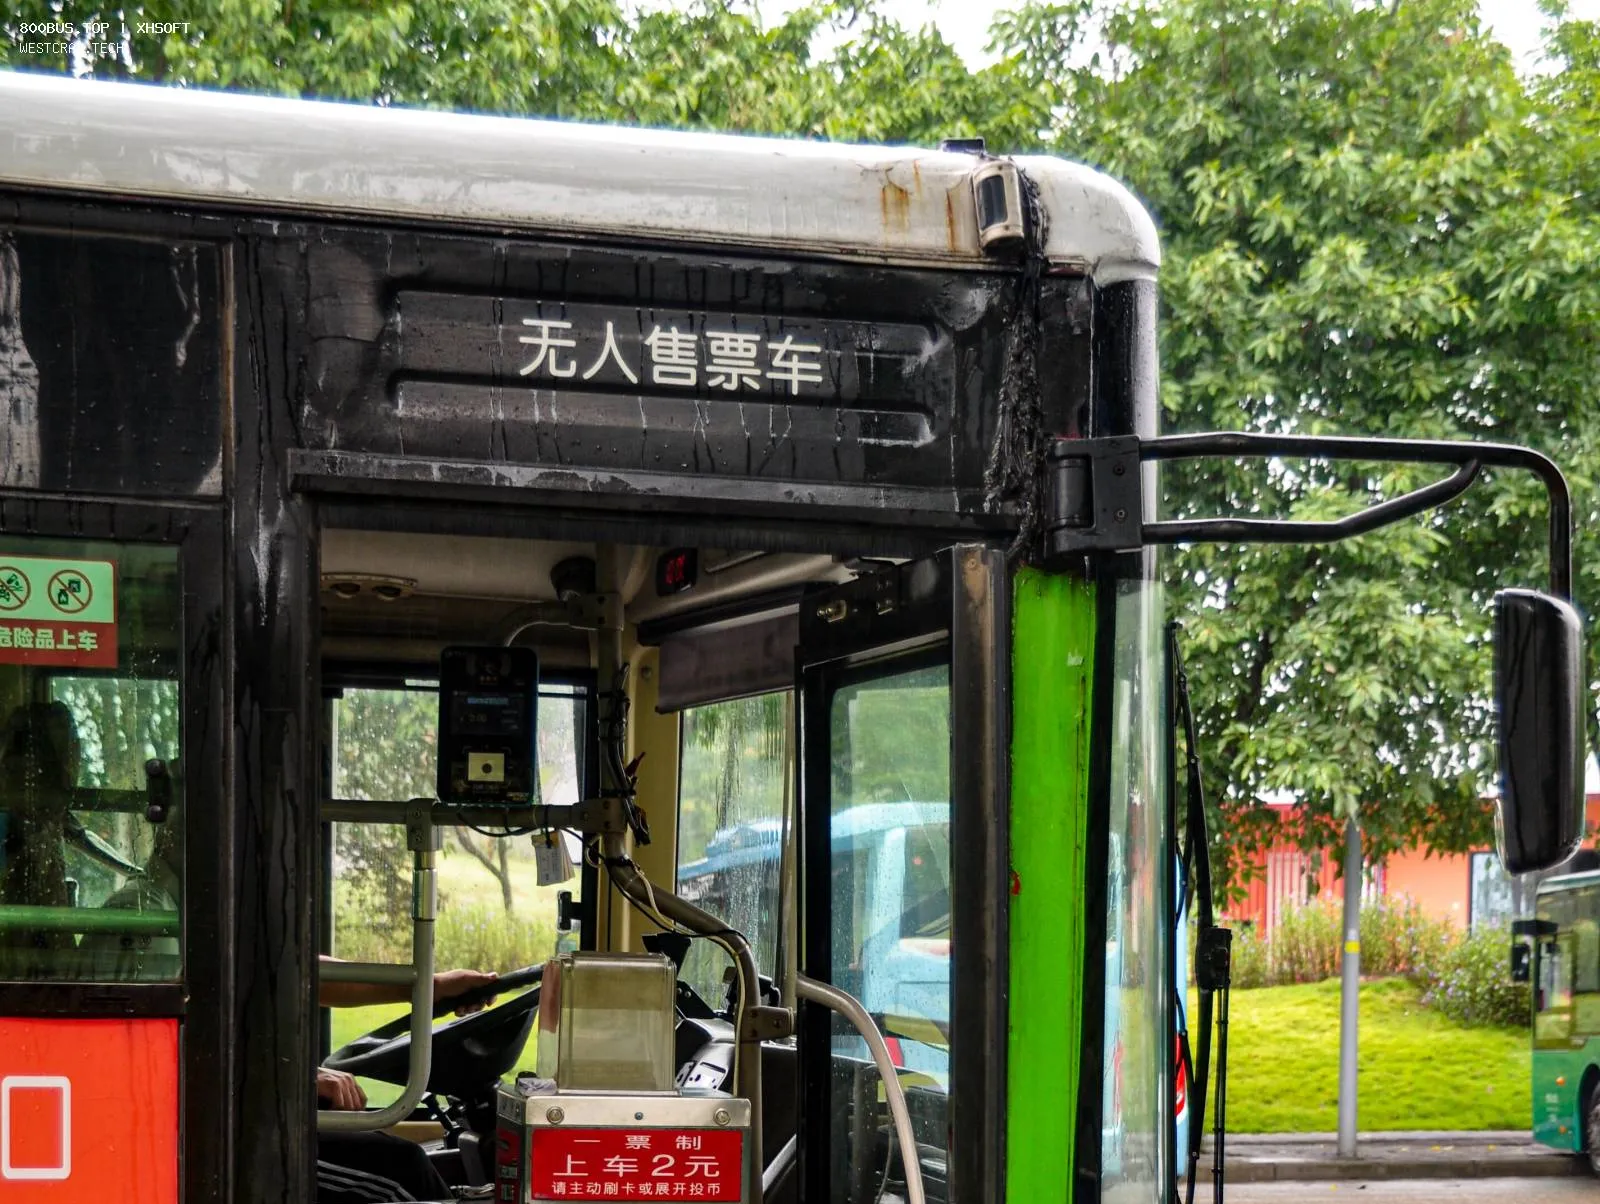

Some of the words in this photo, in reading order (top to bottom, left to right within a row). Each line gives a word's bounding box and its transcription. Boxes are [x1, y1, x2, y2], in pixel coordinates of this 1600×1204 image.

[519, 319, 823, 396] 无人售票车
[574, 1134, 702, 1151] 一票制
[553, 1153, 720, 1178] 上车2元
[552, 1181, 721, 1196] 请主动刷卡或展开投币
